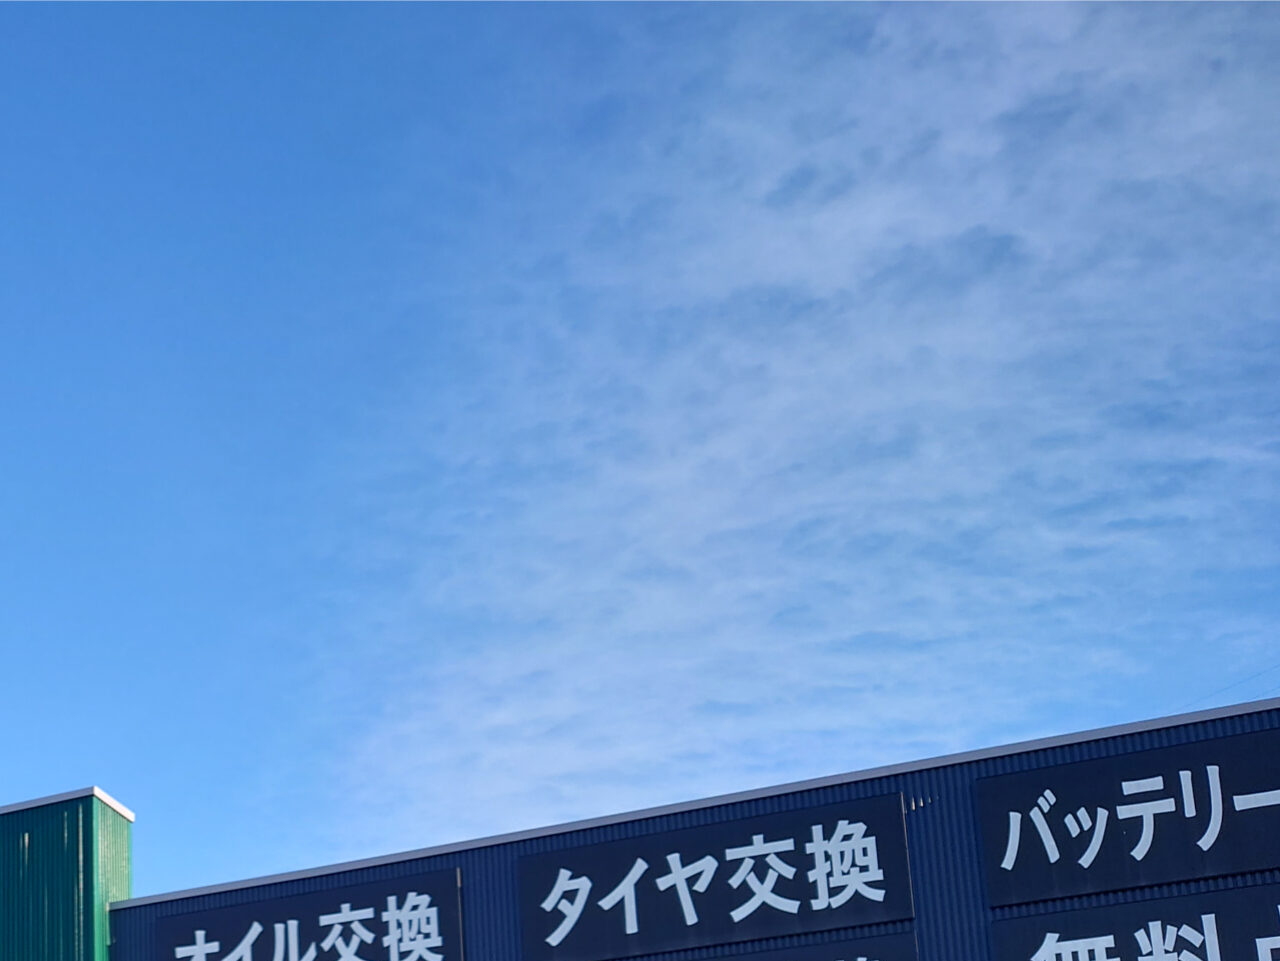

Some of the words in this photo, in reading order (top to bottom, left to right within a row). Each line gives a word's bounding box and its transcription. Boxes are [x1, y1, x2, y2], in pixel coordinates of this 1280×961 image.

[1000, 765, 1280, 871] バッテリー
[540, 819, 887, 947] タイヤ交換
